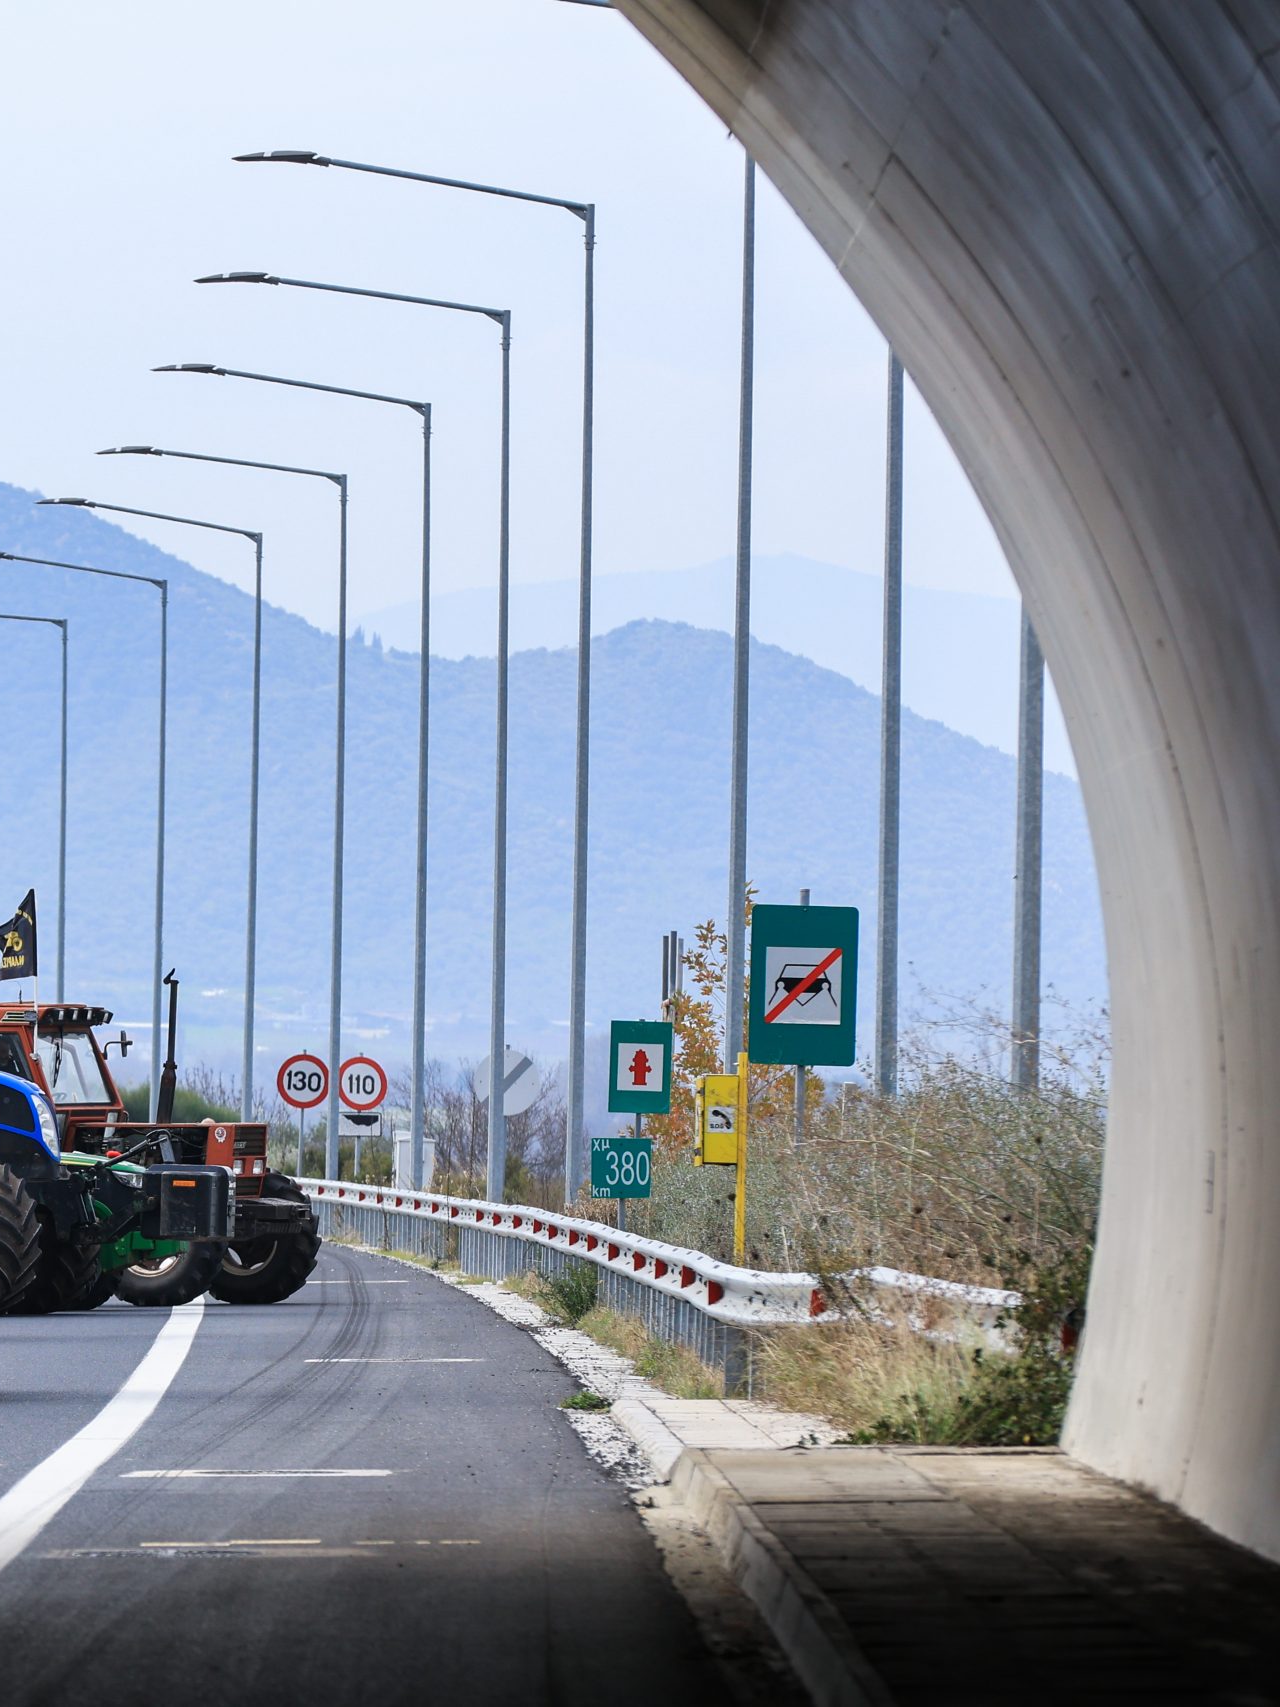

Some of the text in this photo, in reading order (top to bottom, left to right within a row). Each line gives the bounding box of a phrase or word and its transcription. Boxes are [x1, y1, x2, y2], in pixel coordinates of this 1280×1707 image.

[286, 1070, 322, 1093] 130
[348, 1074, 375, 1095] 110
[605, 1151, 650, 1186] 380
[592, 1184, 611, 1197] km
